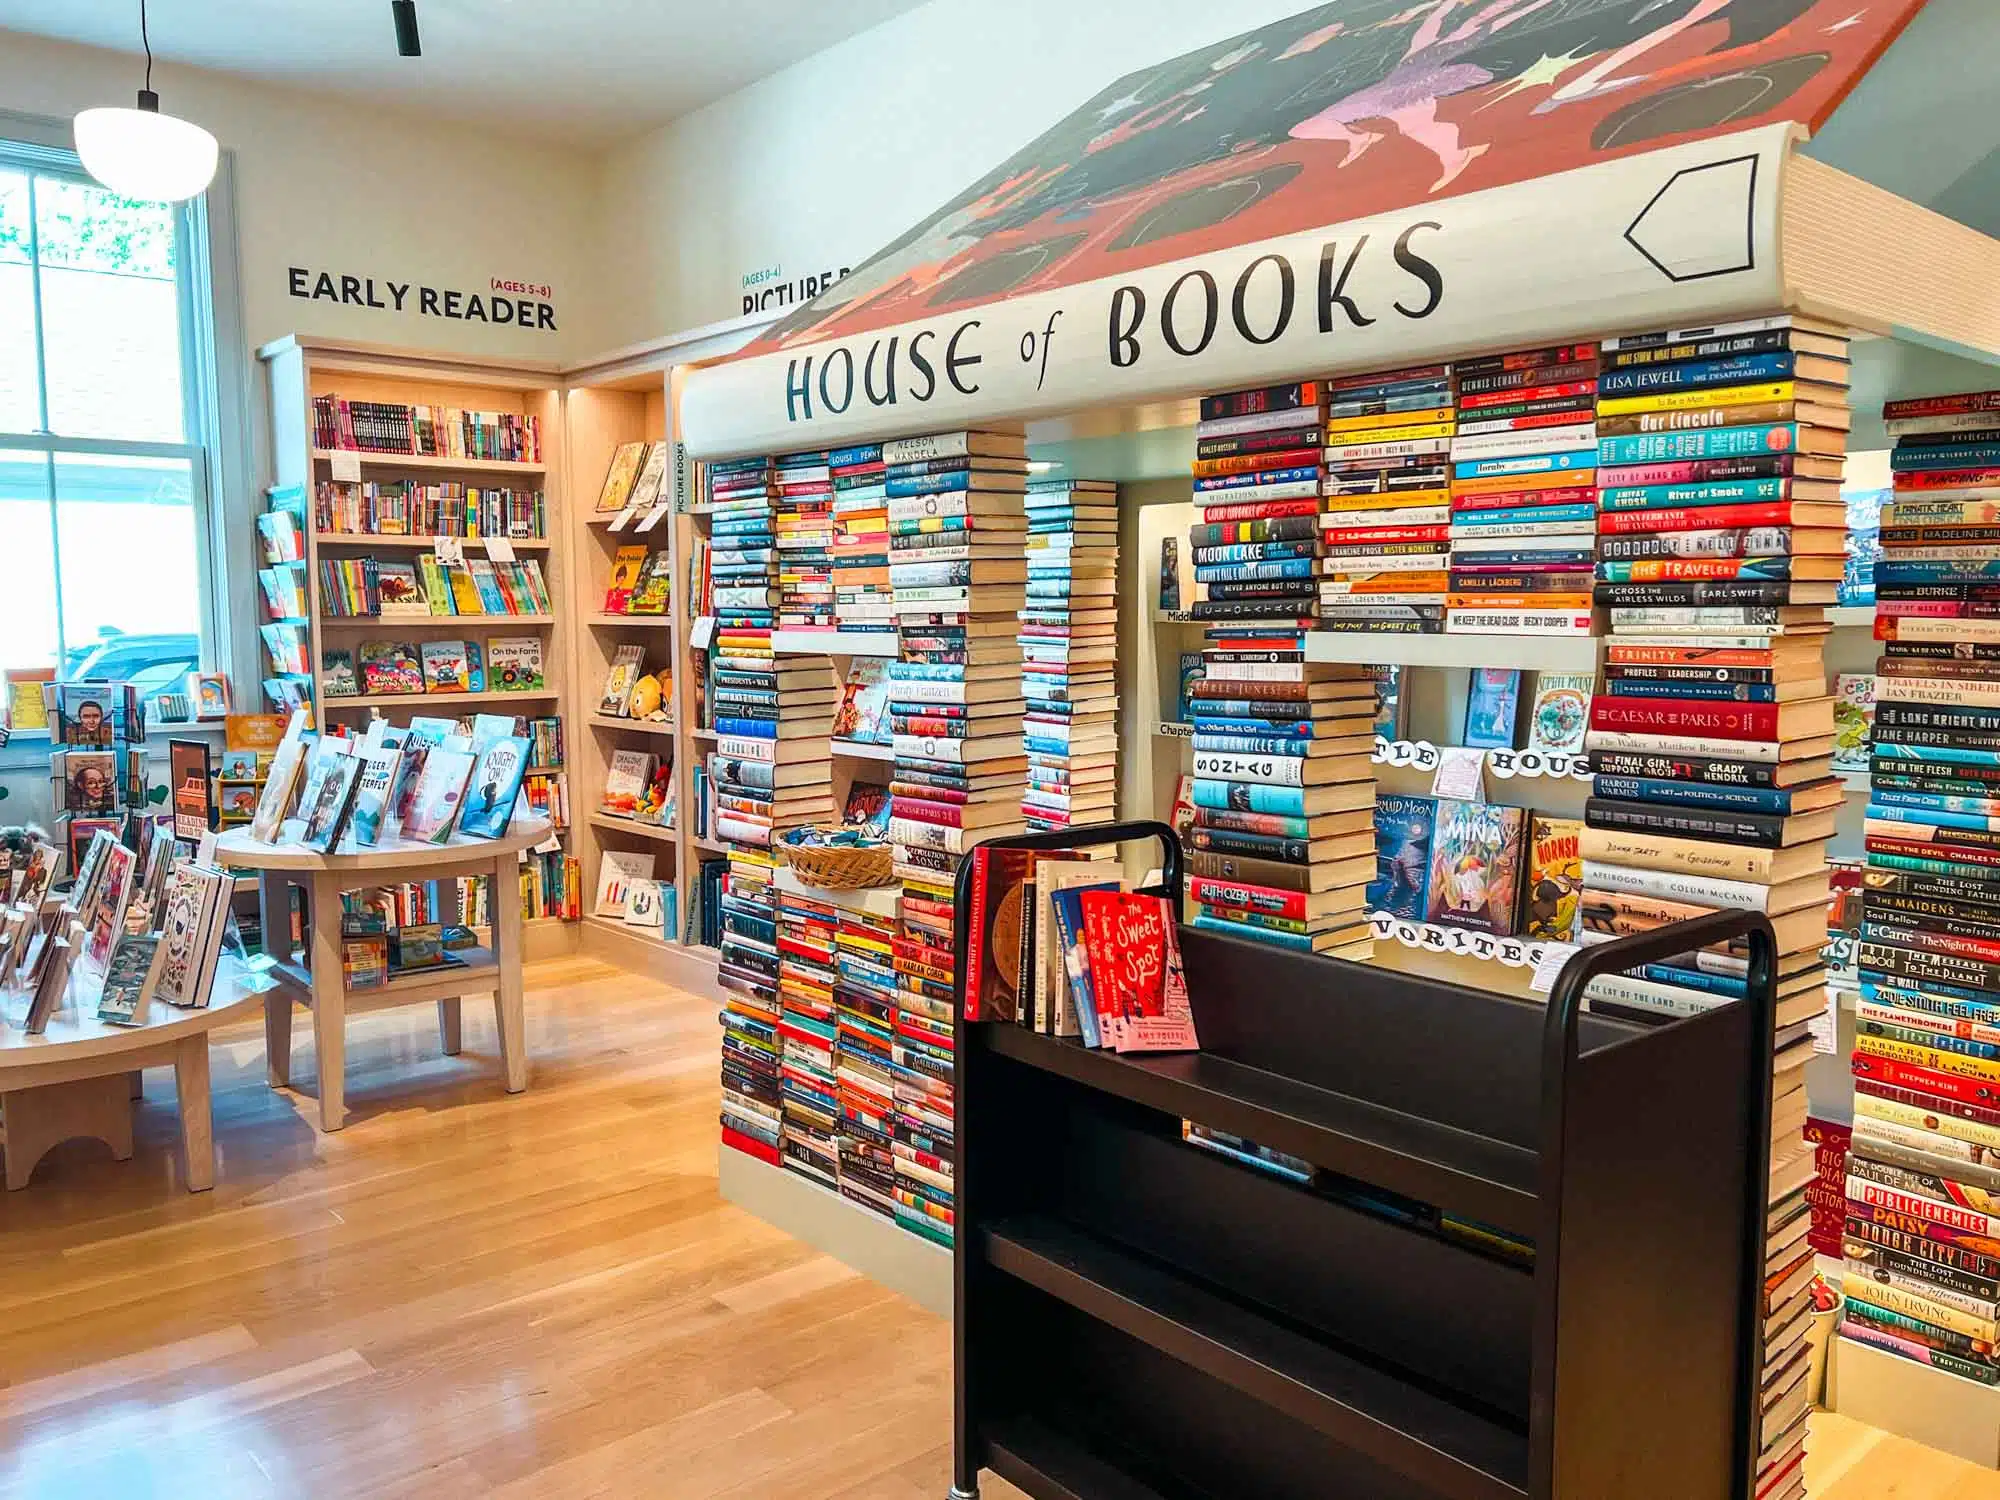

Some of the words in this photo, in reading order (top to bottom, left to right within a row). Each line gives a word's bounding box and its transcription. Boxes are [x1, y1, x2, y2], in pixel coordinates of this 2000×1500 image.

[743, 270, 763, 288] (AGES
[766, 264, 781, 278] 0-4)
[491, 278, 525, 295] (AGES
[528, 282, 551, 299] 5-8)
[743, 272, 831, 315] PICTURE
[288, 268, 408, 310] EARLY
[420, 288, 556, 330] READER
[787, 320, 982, 422] HOUSE
[1020, 311, 1063, 391] of
[1109, 221, 1442, 367] BOOKS
[1723, 361, 1750, 369] NIGHT
[1462, 377, 1490, 392] DENNIS
[1607, 377, 1632, 389] LISA
[1637, 371, 1682, 387] JEWELL
[1640, 414, 1664, 432] Our
[1670, 409, 1724, 429] Lincoln
[898, 438, 935, 448] NELSON
[832, 454, 852, 465] LOUISE
[860, 450, 880, 460] PENNY
[894, 449, 939, 460] MANDELA
[1668, 490, 1695, 500] River
[1711, 488, 1744, 497] Smoke
[1937, 503, 1964, 512] HEART
[1886, 530, 1916, 539] CIRCE
[1923, 529, 1982, 538] MADELINE
[1198, 546, 1230, 562] MOON
[1235, 544, 1263, 560] LAKE
[1888, 550, 1937, 558] MURDER
[1633, 565, 1656, 575] THE
[1916, 587, 1958, 596] BURKE
[1454, 616, 1463, 625] WE
[1463, 616, 1476, 626] KEEP
[1477, 616, 1487, 626] THE
[1488, 616, 1502, 626] DEAD
[1502, 616, 1519, 626] CLOSE
[1524, 616, 1542, 626] BECKY
[1544, 617, 1568, 627] COOPER
[492, 648, 504, 656] On
[519, 647, 539, 655] Farm
[1618, 652, 1677, 660] TRINITY
[1624, 669, 1656, 677] PROFILES
[1668, 671, 1712, 679] LEADERSHIP
[1887, 678, 1937, 688] TRAVELS
[1941, 681, 1953, 689] IN
[1886, 688, 1906, 697] IAN
[1911, 690, 1962, 701] FRAZIER
[1609, 710, 1665, 724] CAESAR
[1680, 713, 1720, 727] PARIS
[1902, 712, 1929, 724] LONG
[1933, 713, 1974, 727] BRIGHT
[1244, 726, 1257, 734] Girl
[1876, 729, 1902, 741] JANE
[1907, 732, 1949, 744] HARPER
[485, 751, 518, 770] KNIGHT
[1197, 758, 1273, 776] SONTAG
[1615, 756, 1644, 766] FINAL
[1647, 758, 1671, 769] GIRL
[487, 767, 506, 782] OWL
[1600, 764, 1640, 774] SUPPORT
[1708, 763, 1744, 774] GRADY
[1879, 761, 1895, 770] NOT
[1897, 762, 1906, 771] IN
[1909, 764, 1924, 773] THE
[1926, 765, 1952, 776] FLESH
[1600, 779, 1639, 789] HAROLD
[1704, 773, 1748, 783] HENDRIX
[1601, 787, 1639, 797] VARMUS
[1660, 789, 1673, 797] ART
[1684, 791, 1717, 800] POLITICS
[1725, 794, 1758, 803] SCIENCE
[1446, 816, 1502, 845] MINA
[1871, 842, 1901, 851] RACING
[1903, 846, 1919, 854] THE
[1921, 848, 1945, 857] DEVIL
[1950, 852, 1988, 862] CHARLES
[916, 856, 941, 869] SONG
[1913, 883, 1964, 896] FOUNDING
[1936, 878, 1956, 887] THE
[1959, 882, 1984, 890] LOST
[1200, 884, 1222, 897] RUTH
[1224, 885, 1249, 901] OZEKI
[1670, 883, 1705, 895] COLUM
[1710, 890, 1753, 903] McCANN
[1128, 903, 1142, 916] The
[1620, 904, 1657, 919] Thomas
[1896, 899, 1955, 915] MAIDENS
[1866, 910, 1886, 920] Saul
[1888, 913, 1920, 925] Bellow
[1117, 913, 1159, 948] Sweet
[1860, 943, 1896, 958] IRIS
[968, 945, 977, 985] LIBRARY
[1126, 944, 1160, 988] Spot
[1908, 950, 1929, 962] THE
[1931, 955, 1988, 972] MESSAGE
[903, 961, 925, 976] HARLAN
[927, 967, 945, 980] COBEN
[1904, 962, 1920, 973] TO
[1921, 963, 1942, 977] THE
[1943, 969, 1988, 985] PLANET
[1897, 978, 1920, 990] WALL
[1603, 987, 1618, 996] LAY
[1620, 990, 1631, 999] OF
[1634, 992, 1650, 1002] THE
[1652, 995, 1674, 1008] LAND
[1876, 989, 1906, 1003] ZADIE
[1907, 994, 1942, 1013] SMITH
[1945, 1002, 1972, 1018] FEEL
[1861, 1008, 1878, 1016] THE
[1880, 1010, 1953, 1032] FLAMETHROWERS
[1861, 1039, 1924, 1058] BARBARA
[1860, 1046, 1924, 1064] KINGSOLVER
[1942, 1064, 1996, 1080] LACUNA
[1899, 1072, 1936, 1086] STEPHEN
[1822, 1149, 1842, 1167] BIG
[1816, 1163, 1846, 1185] IDEAS
[1852, 1166, 1882, 1182] PAUL
[1884, 1173, 1900, 1186] DE
[1853, 1158, 1868, 1167] THE
[1922, 1177, 1934, 1186] OF
[1868, 1188, 1923, 1215] PUBLIC
[1925, 1202, 1986, 1234] ENEMIES
[1873, 1207, 1930, 1236] PATSY
[1861, 1220, 1912, 1253] DODGE
[1919, 1239, 1957, 1266] CITY
[1909, 1258, 1929, 1269] THE
[1931, 1265, 1954, 1278] LOST
[1889, 1261, 1935, 1280] FOUNDING
[1939, 1275, 1974, 1291] FATHER
[1863, 1285, 1901, 1305] JOHN
[1904, 1294, 1951, 1322] IRVING
